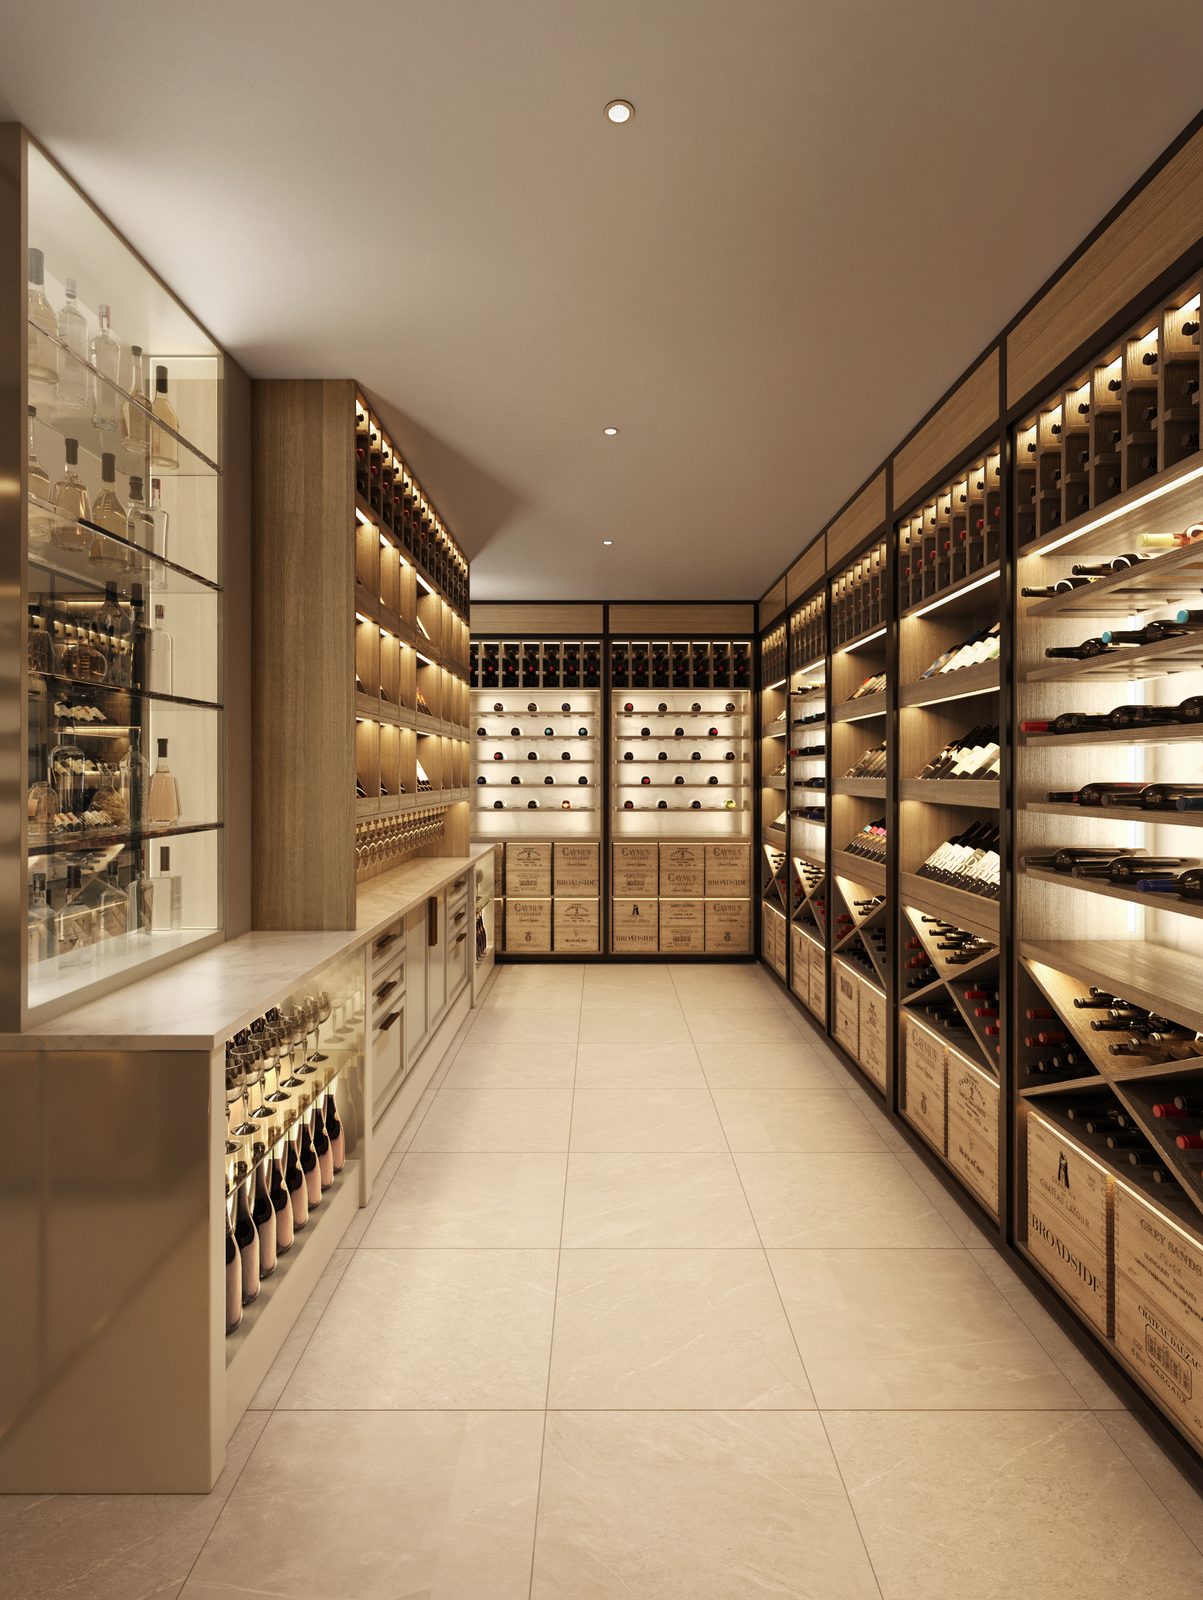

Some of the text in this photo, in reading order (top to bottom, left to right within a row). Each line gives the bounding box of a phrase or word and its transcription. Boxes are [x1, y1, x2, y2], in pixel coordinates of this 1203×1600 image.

[667, 872, 697, 881] CAYMUS
[1032, 1214, 1102, 1298] BROADSIDE
[1140, 1218, 1203, 1277] GREY SANDS
[1149, 1362, 1187, 1406] MARGAUX
